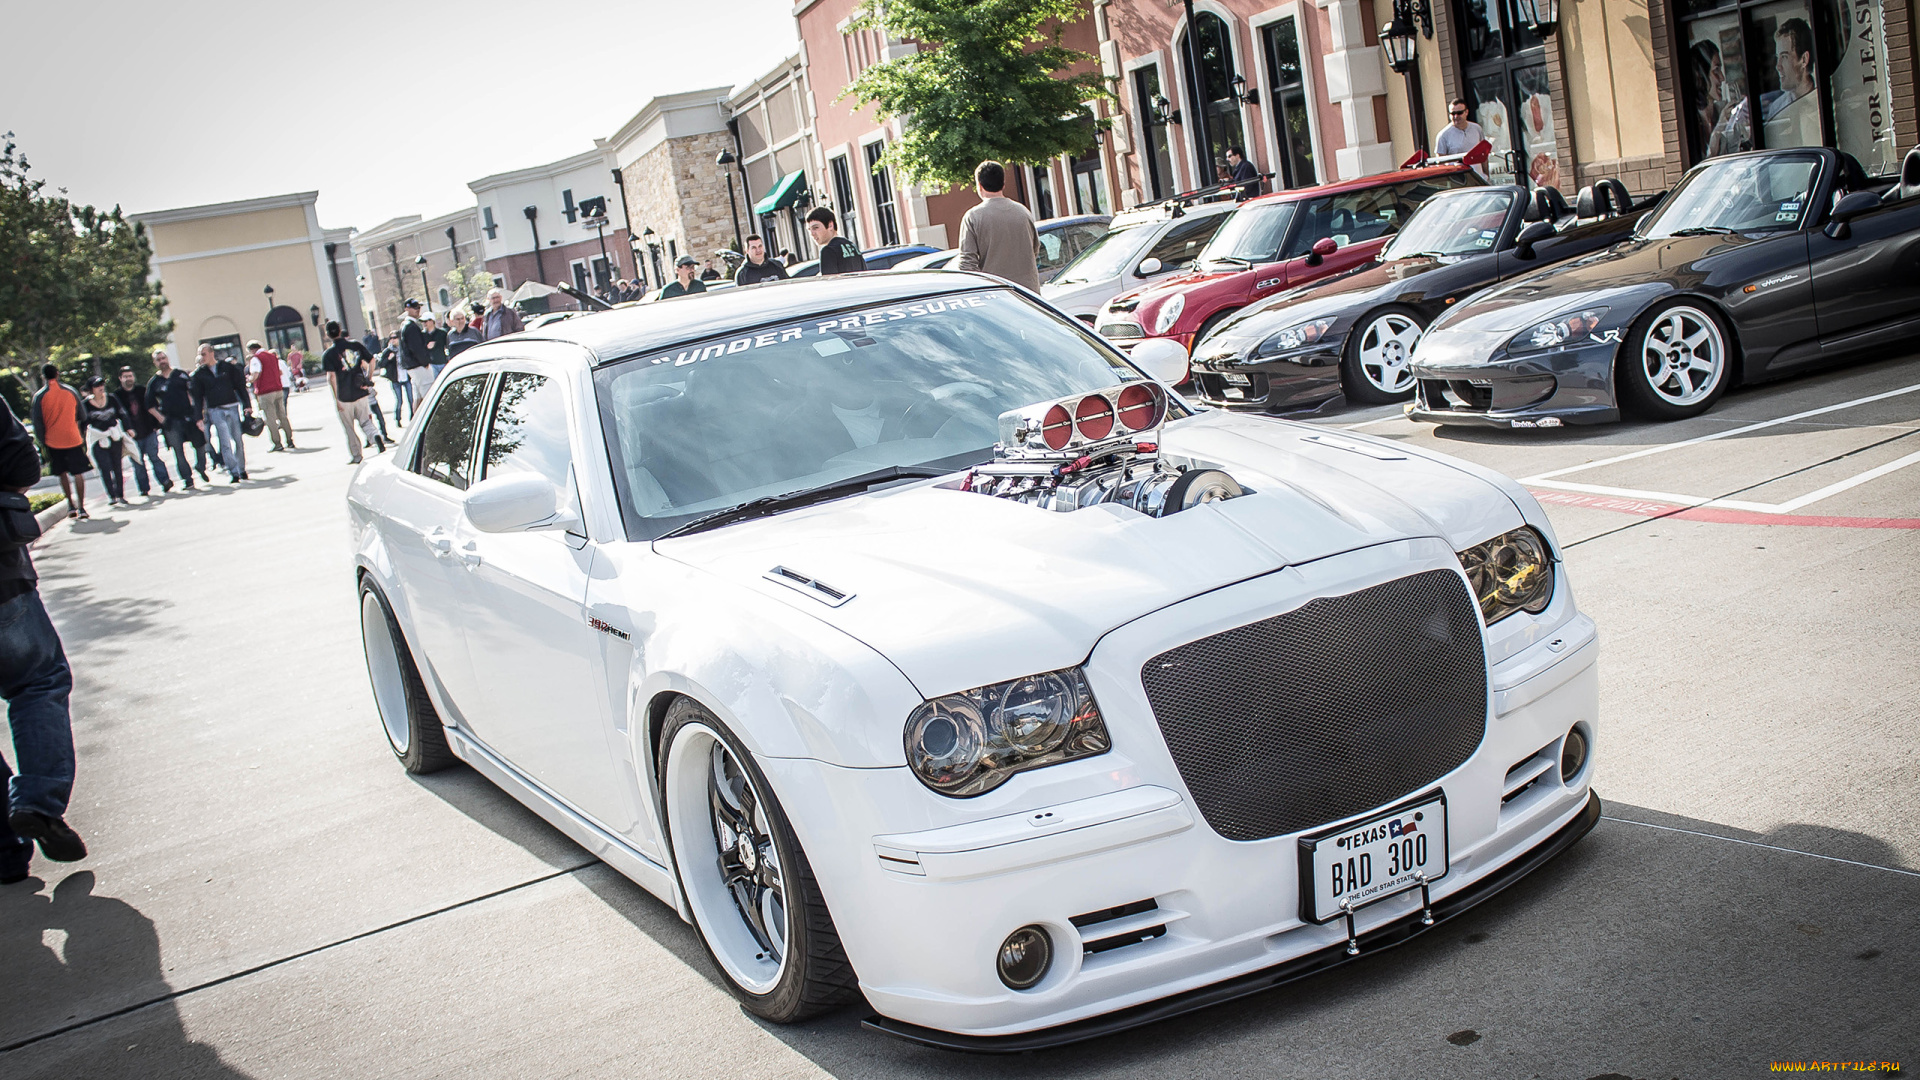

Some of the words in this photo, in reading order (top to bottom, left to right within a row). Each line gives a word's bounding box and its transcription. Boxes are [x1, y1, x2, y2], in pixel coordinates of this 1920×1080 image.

[1868, 92, 1884, 143] FOR
[1761, 274, 1798, 287] Honda
[1592, 499, 1667, 512] ZONE
[588, 614, 608, 632] 392
[1345, 824, 1387, 851] TEXAS
[1331, 852, 1372, 898] BAD
[1388, 833, 1427, 877] 300
[1348, 893, 1361, 902] THE
[1361, 886, 1379, 897] LONE
[1379, 880, 1396, 891] STAR
[1396, 874, 1415, 885] STATE
